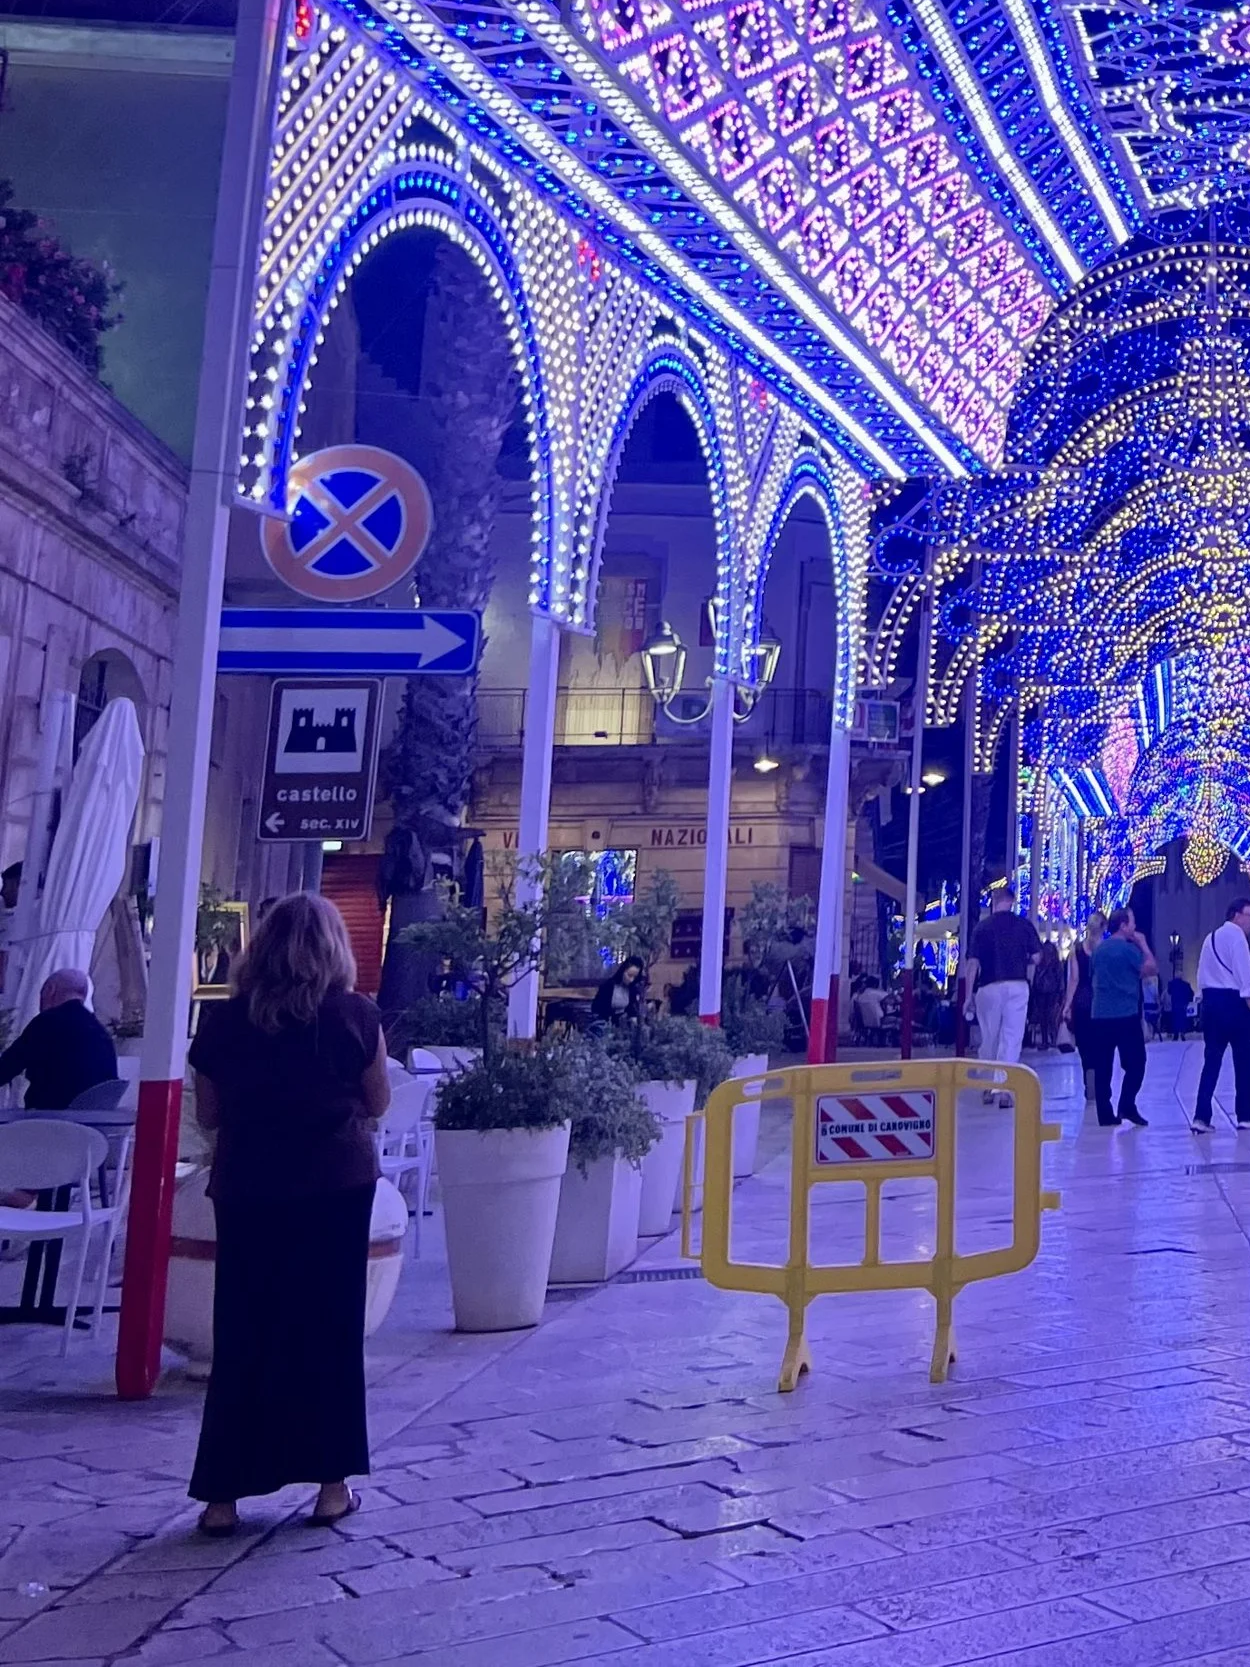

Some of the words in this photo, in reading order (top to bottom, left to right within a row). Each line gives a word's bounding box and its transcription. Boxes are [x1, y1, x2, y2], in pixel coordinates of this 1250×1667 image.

[277, 786, 357, 802] castello
[300, 818, 332, 830] sec.
[651, 827, 752, 845] NAZIOLI
[829, 1123, 865, 1135] COMUNE
[868, 1123, 877, 1133] DI
[880, 1119, 931, 1132] CAROVIGNO
